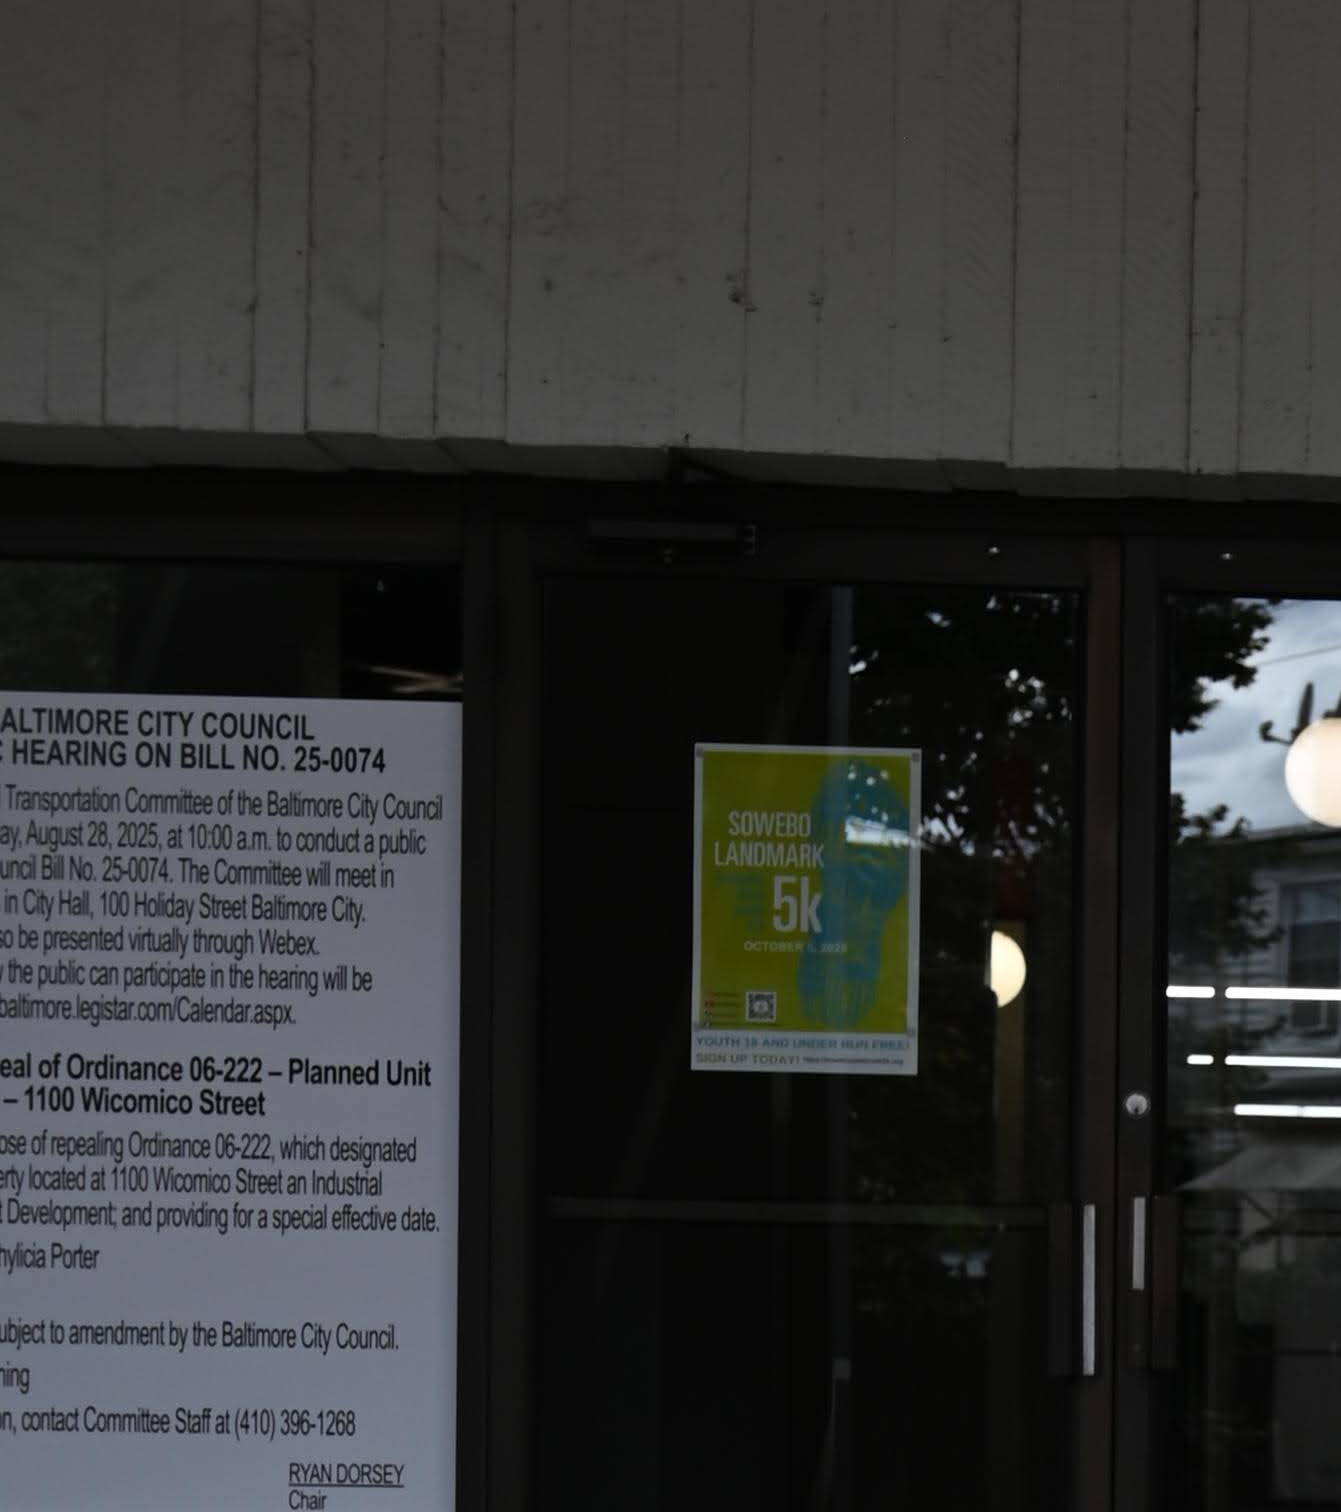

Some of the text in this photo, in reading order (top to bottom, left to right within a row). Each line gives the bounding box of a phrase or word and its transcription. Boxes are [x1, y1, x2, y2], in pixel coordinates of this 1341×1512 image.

[0, 707, 315, 740] ALTIMORE CITY COUNCIL
[12, 738, 127, 767] HEARING
[135, 741, 171, 768] ON
[180, 742, 235, 770] BILL
[243, 744, 286, 771] NO.
[294, 746, 386, 773] 25-0074
[6, 784, 443, 826] Transportation Committee of the Baltimore City Council
[25, 820, 84, 855] August
[87, 820, 112, 850] 28,
[117, 821, 162, 852] 2025,
[166, 824, 184, 849] at
[188, 823, 233, 851] 10:00
[236, 830, 272, 852] a.m.
[276, 824, 292, 852] to
[296, 826, 360, 853] conduct
[364, 833, 374, 854] a
[379, 828, 427, 861] public
[728, 811, 812, 837] SOWEBO
[41, 850, 65, 880] Bill
[69, 855, 97, 882] No.
[102, 855, 173, 883] 25-0074.
[177, 857, 210, 885] The
[214, 858, 302, 887] Committee
[306, 861, 331, 887] will
[335, 864, 377, 888] meet
[380, 866, 394, 888] in
[714, 842, 825, 868] LANDMARK
[4, 888, 365, 929] in City Hall, 100 Holiday Street Baltimore City.
[18, 923, 39, 950] be
[43, 925, 124, 956] presented
[128, 925, 191, 960] virtually
[193, 928, 254, 961] through
[259, 928, 320, 956] Webex.
[8, 957, 33, 984] the
[37, 957, 85, 991] public
[89, 966, 119, 986] can
[123, 956, 206, 994] participate
[210, 961, 224, 989] in
[229, 963, 254, 989] the
[258, 963, 319, 998] hearing
[322, 964, 347, 991] will
[352, 965, 372, 992] be
[38, 1052, 62, 1079] of
[66, 1053, 183, 1082] Ordinance
[190, 1056, 263, 1083] 06-222
[289, 1058, 379, 1086] Planned
[387, 1060, 431, 1087] Unit
[24, 1085, 74, 1112] 1100
[80, 1086, 193, 1115] Wicomico
[199, 1088, 265, 1116] Street
[31, 1129, 48, 1156] of
[51, 1132, 124, 1165] repealing
[128, 1130, 211, 1160] Ordinance
[215, 1132, 275, 1164] 06-222,
[280, 1134, 325, 1161] which
[329, 1136, 416, 1171] designated
[29, 1164, 86, 1191] located
[90, 1165, 106, 1191] at
[111, 1164, 149, 1192] 1100
[153, 1166, 231, 1194] Wicomico
[235, 1167, 283, 1195] Street
[287, 1175, 307, 1195] an
[312, 1166, 382, 1197] Industrial
[7, 1198, 117, 1232] Development;
[122, 1200, 152, 1227] and
[156, 1201, 228, 1236] providing
[233, 1201, 254, 1229] for
[257, 1209, 268, 1229] a
[272, 1203, 327, 1236] special
[331, 1203, 397, 1231] effective
[401, 1205, 439, 1232] date.
[51, 1242, 100, 1270] Porter
[49, 1320, 65, 1344] to
[69, 1320, 165, 1346] amendment
[169, 1320, 189, 1354] by
[192, 1321, 217, 1347] the
[222, 1320, 297, 1348] Baltimore
[301, 1322, 332, 1356] City
[336, 1322, 399, 1350] Council.
[0, 1405, 357, 1442] n, contact Committee Staff at (410) 396-1268
[289, 1462, 404, 1485] RYAN DORSEY
[287, 1490, 328, 1510] Chair
